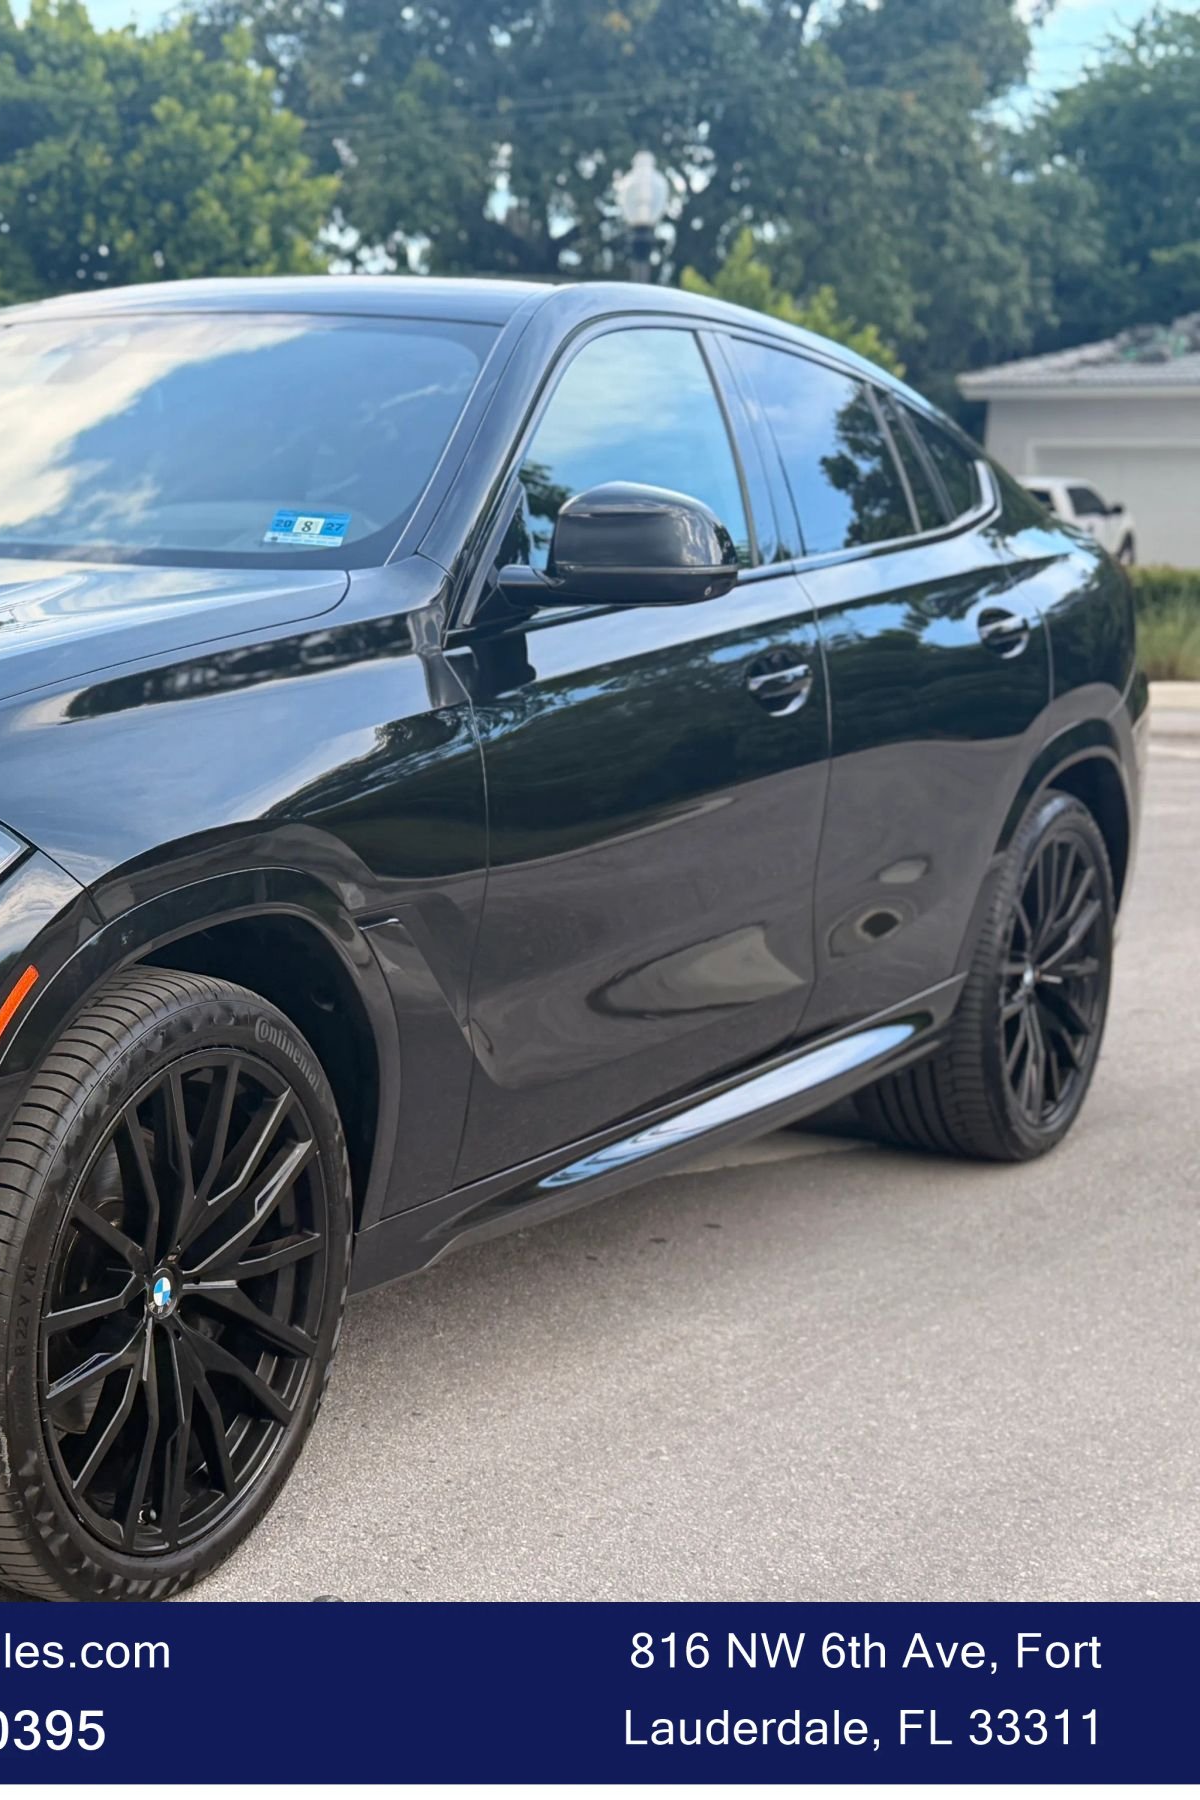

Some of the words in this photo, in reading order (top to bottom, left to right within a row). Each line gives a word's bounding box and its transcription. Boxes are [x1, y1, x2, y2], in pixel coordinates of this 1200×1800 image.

[275, 519, 293, 528] 20
[301, 520, 314, 533] 8
[325, 522, 345, 532] 27
[254, 1015, 321, 1092] Continental
